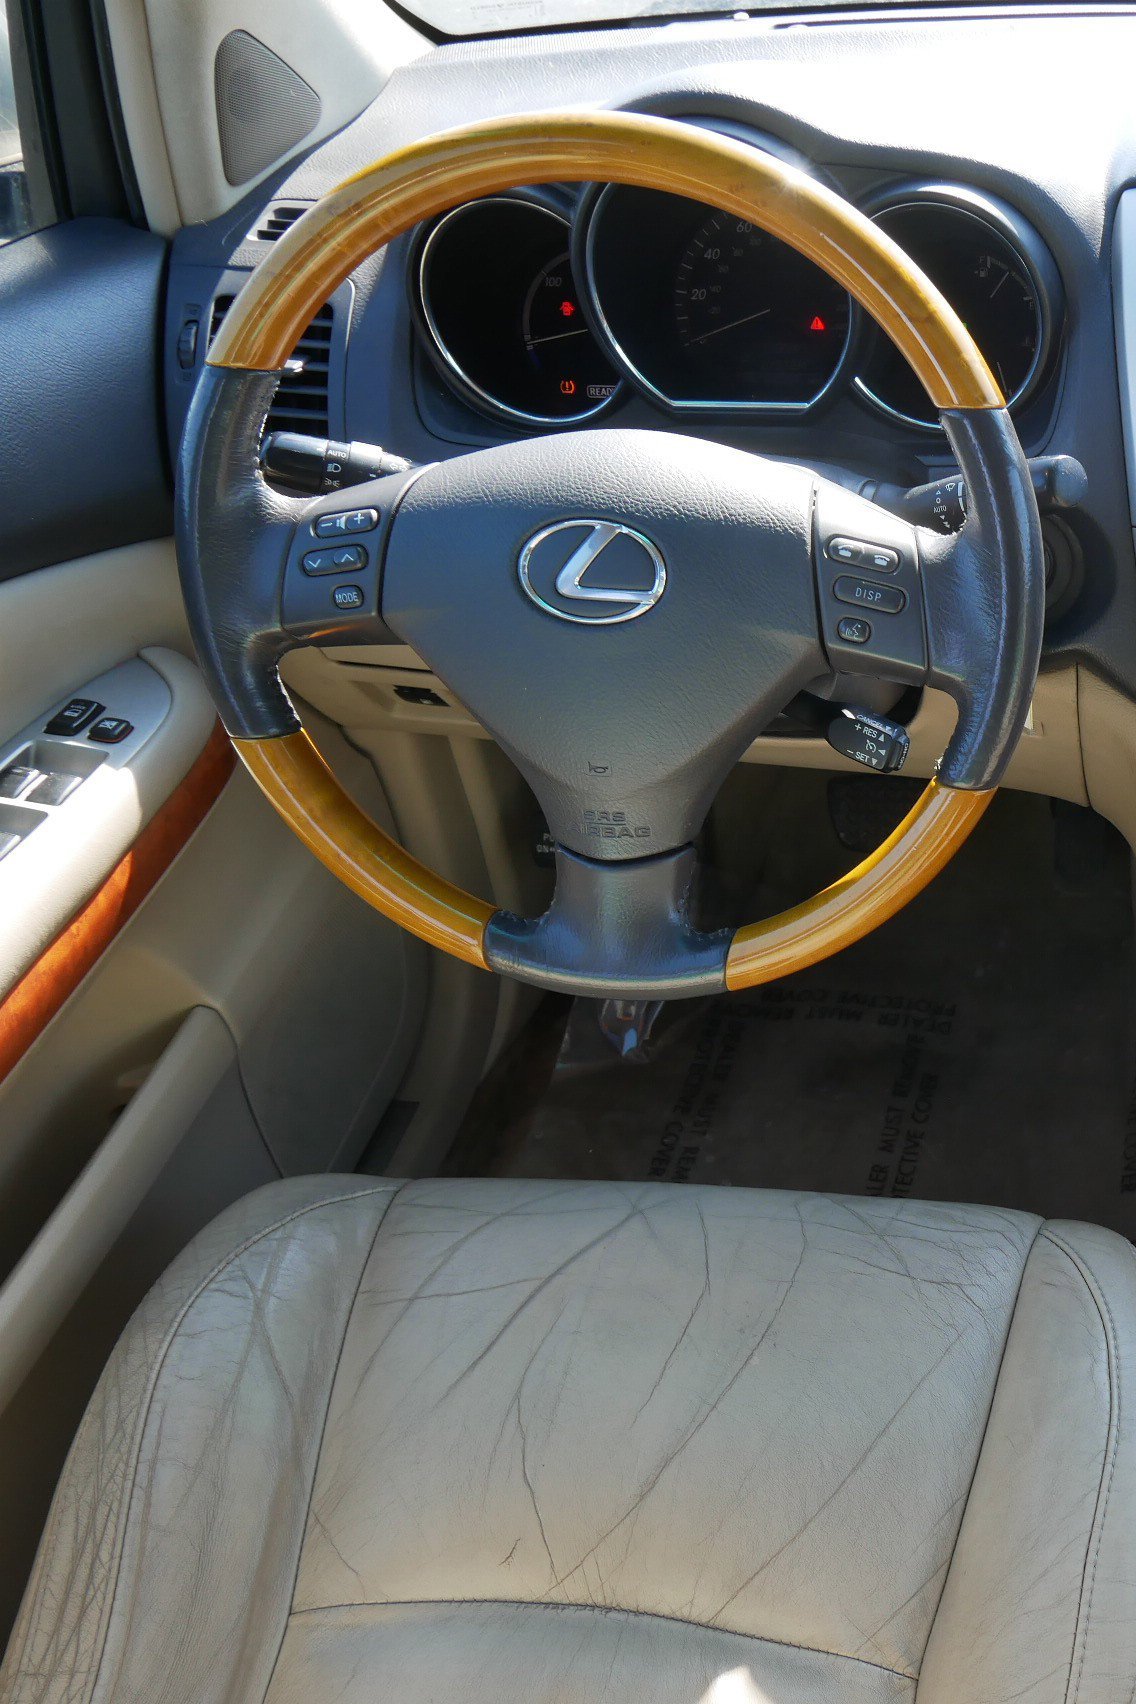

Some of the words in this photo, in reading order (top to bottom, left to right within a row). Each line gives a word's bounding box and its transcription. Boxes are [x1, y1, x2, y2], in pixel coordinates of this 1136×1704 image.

[704, 248, 720, 260] 40
[690, 288, 707, 300] 20
[590, 387, 616, 397] READ
[327, 449, 347, 459] AUTO
[933, 504, 947, 514] AUTO
[335, 592, 358, 603] MODE
[855, 586, 882, 602] DISP
[862, 726, 878, 739] RES
[855, 751, 870, 763] SET
[583, 810, 627, 822] SRS
[877, 1105, 905, 1153] MUST
[891, 1129, 925, 1193] TECTIVE
[865, 1163, 890, 1192] LER
